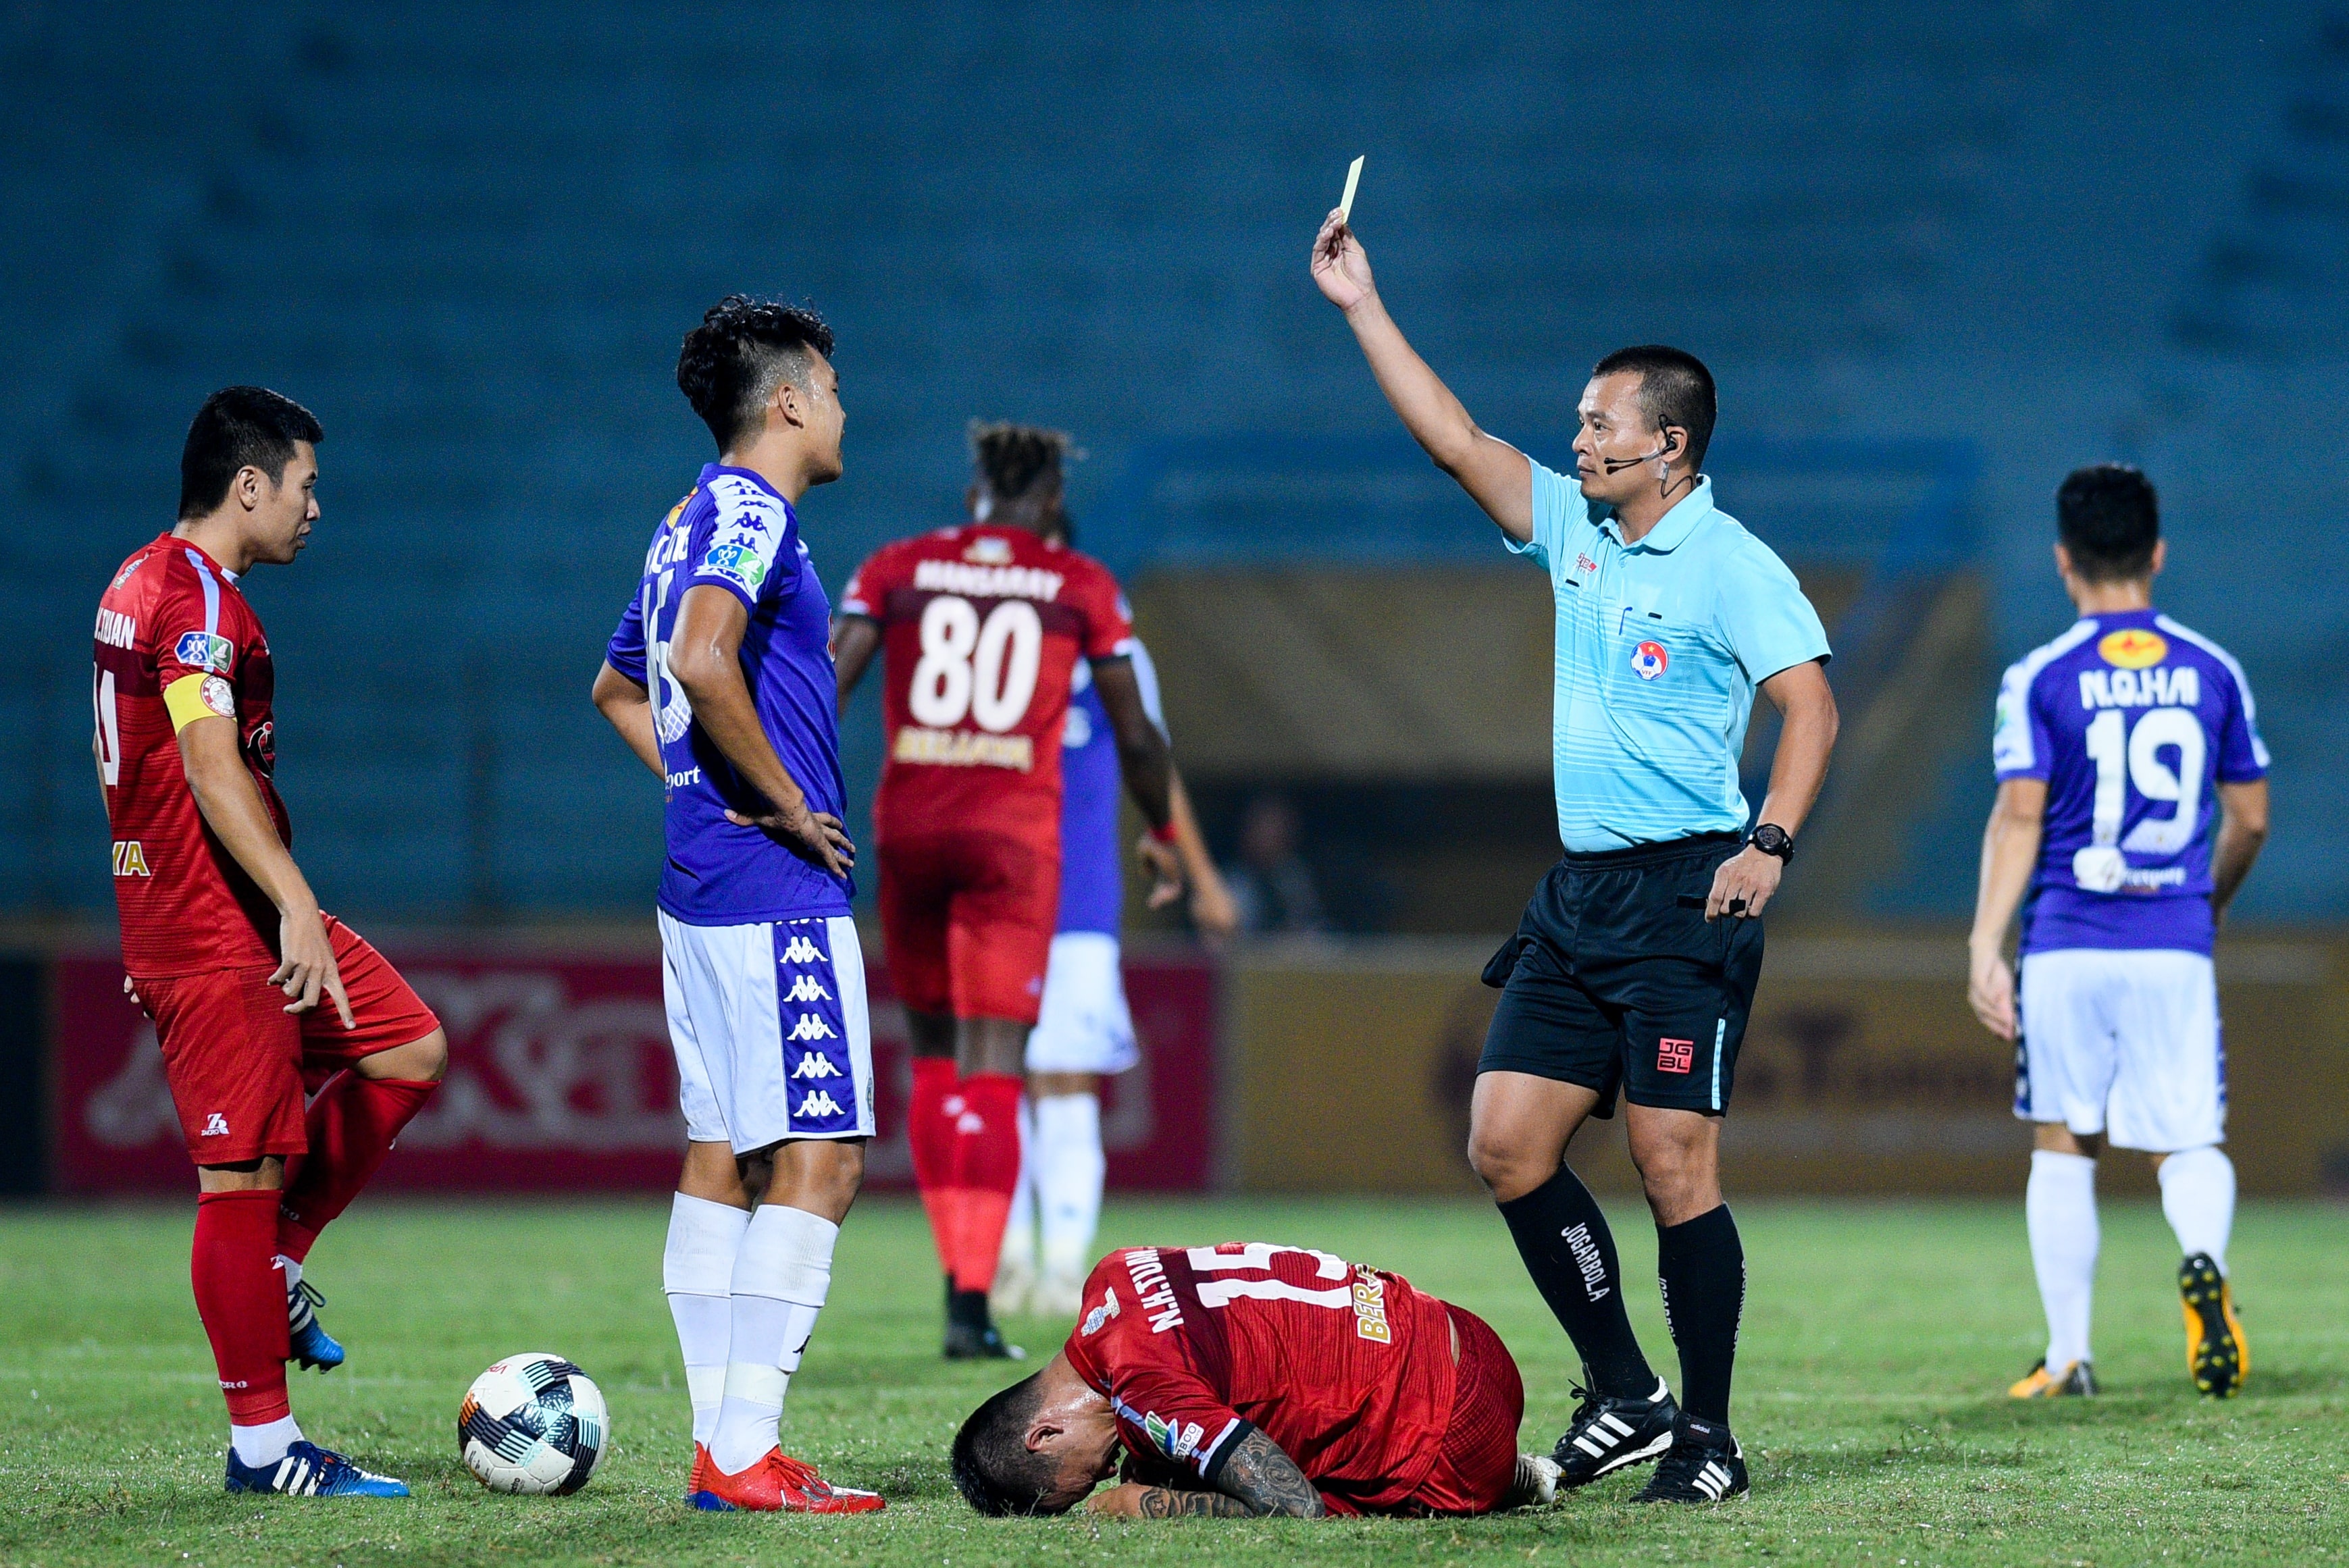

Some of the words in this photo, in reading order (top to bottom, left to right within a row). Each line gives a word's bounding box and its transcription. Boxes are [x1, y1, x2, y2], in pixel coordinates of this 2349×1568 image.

[908, 594, 1043, 732] 80
[2086, 706, 2206, 855] 19
[1186, 1242, 1353, 1309] 15
[1561, 1222, 1610, 1302] JOGARBOLA
